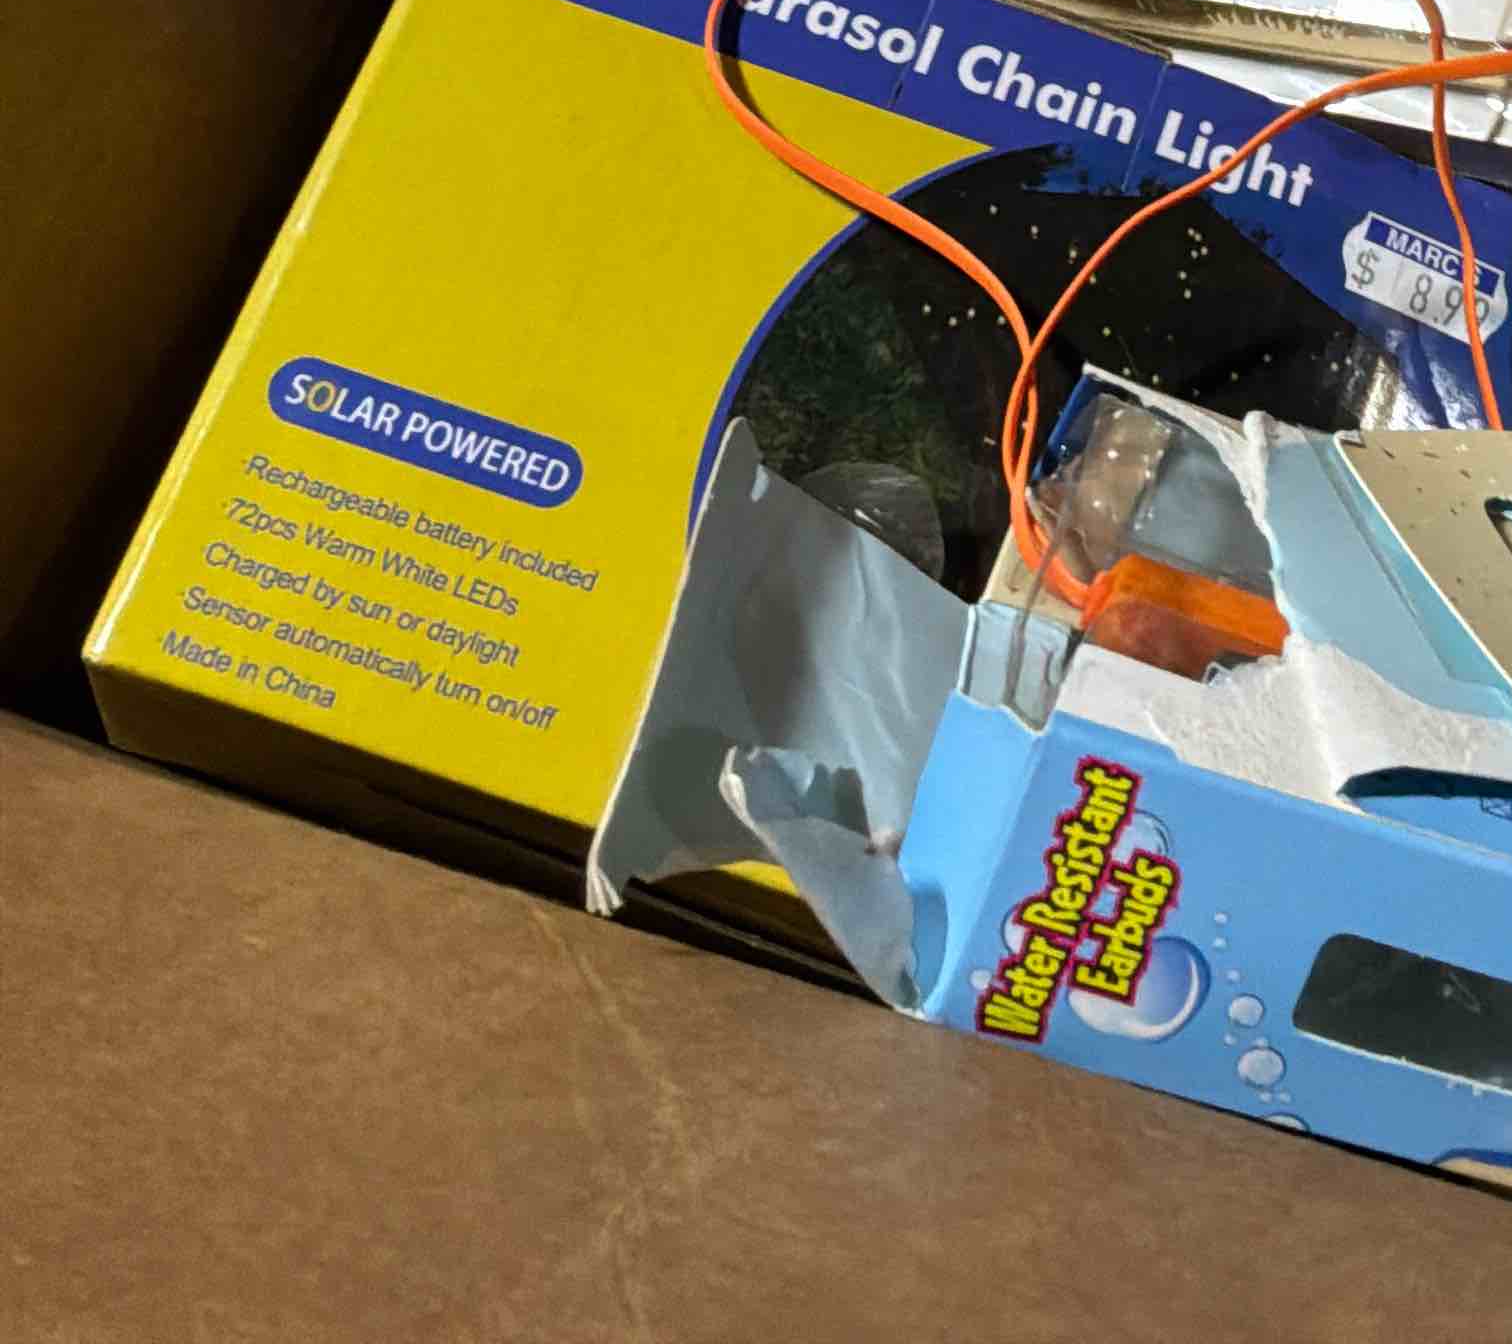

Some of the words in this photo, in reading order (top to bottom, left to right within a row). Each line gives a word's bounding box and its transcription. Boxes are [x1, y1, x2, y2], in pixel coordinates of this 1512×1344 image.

[956, 43, 1140, 146] Chain
[1153, 108, 1317, 210] Light
[1385, 226, 1484, 289] MARCS
[284, 373, 402, 440] SOLAR
[402, 410, 571, 494] POWERED
[224, 498, 299, 543] 72pcs
[304, 522, 376, 567] Warm
[381, 550, 450, 592] White
[452, 573, 520, 617] LEDs
[244, 454, 410, 528] Rechargeable
[413, 511, 498, 561] battery
[498, 538, 600, 593] included
[182, 586, 273, 634] Sensor
[273, 618, 431, 694] automatically
[433, 670, 482, 706] turn
[485, 687, 559, 731] on/off
[204, 540, 309, 599] Charged
[313, 576, 346, 612] by
[348, 593, 393, 626] sun
[397, 612, 425, 634] or
[425, 619, 521, 669] daylight
[160, 629, 233, 674] Made
[235, 656, 261, 683] in
[264, 665, 337, 710] China
[1020, 765, 1136, 936] Resistant
[981, 931, 1073, 1037] Water
[1072, 855, 1176, 998] Earbuds
